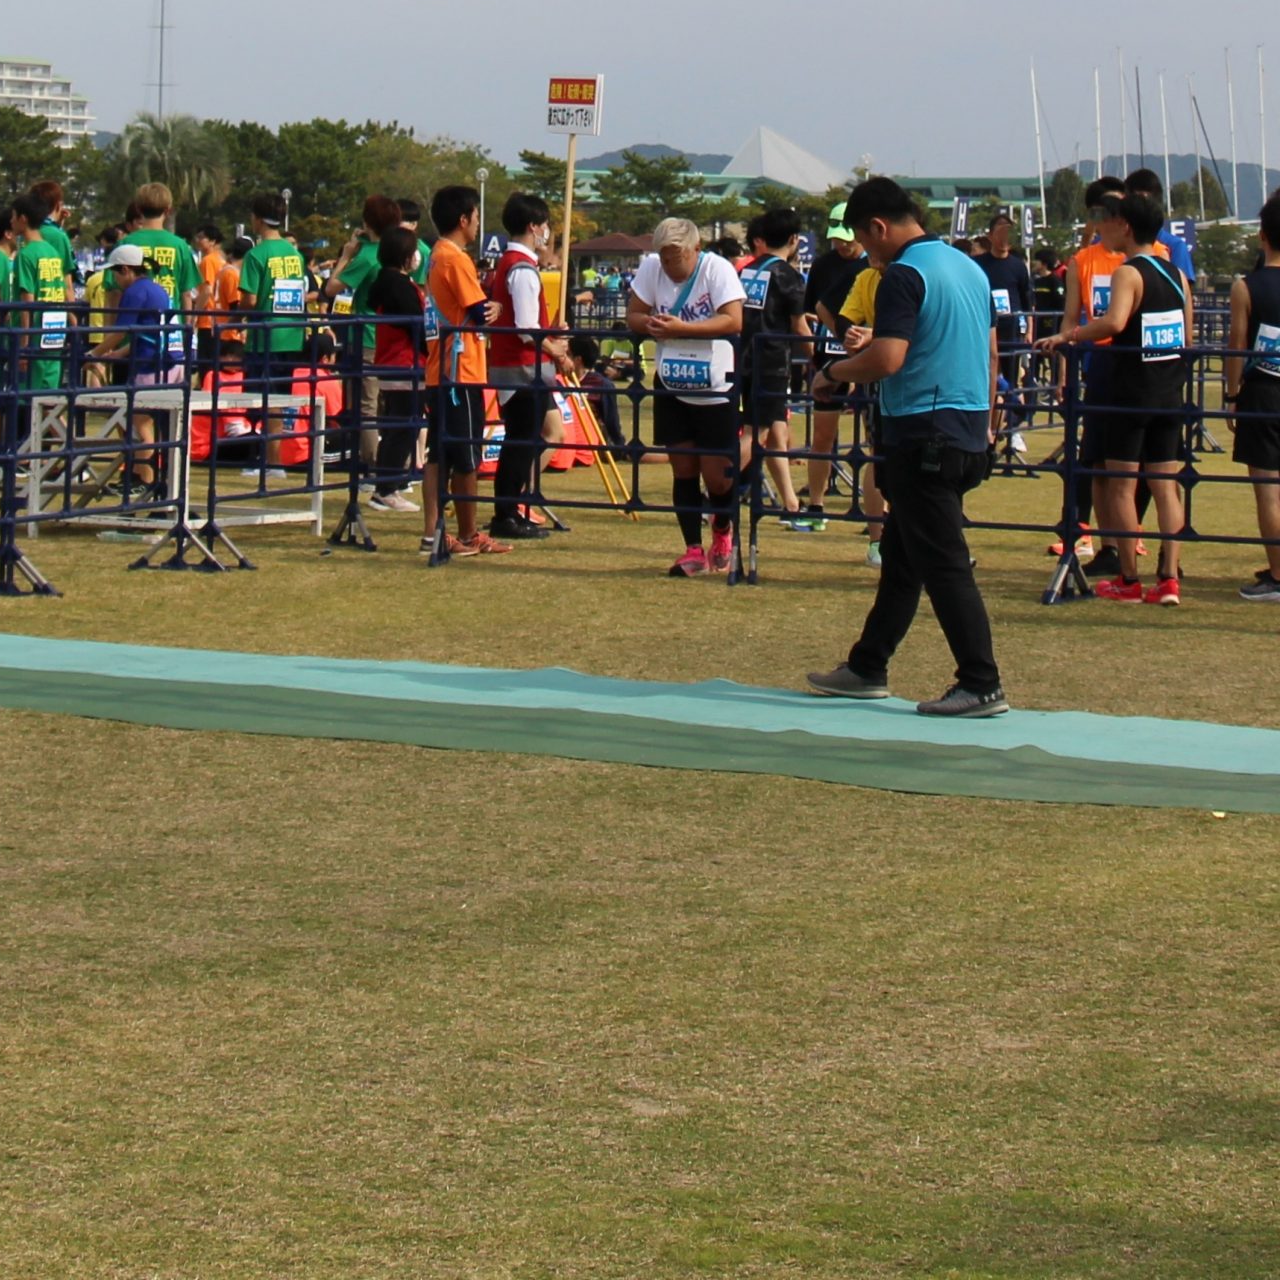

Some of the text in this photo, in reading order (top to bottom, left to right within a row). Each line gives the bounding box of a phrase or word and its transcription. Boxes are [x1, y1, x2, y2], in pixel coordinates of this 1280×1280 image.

[487, 236, 500, 252] A
[663, 362, 709, 380] B 344-1
